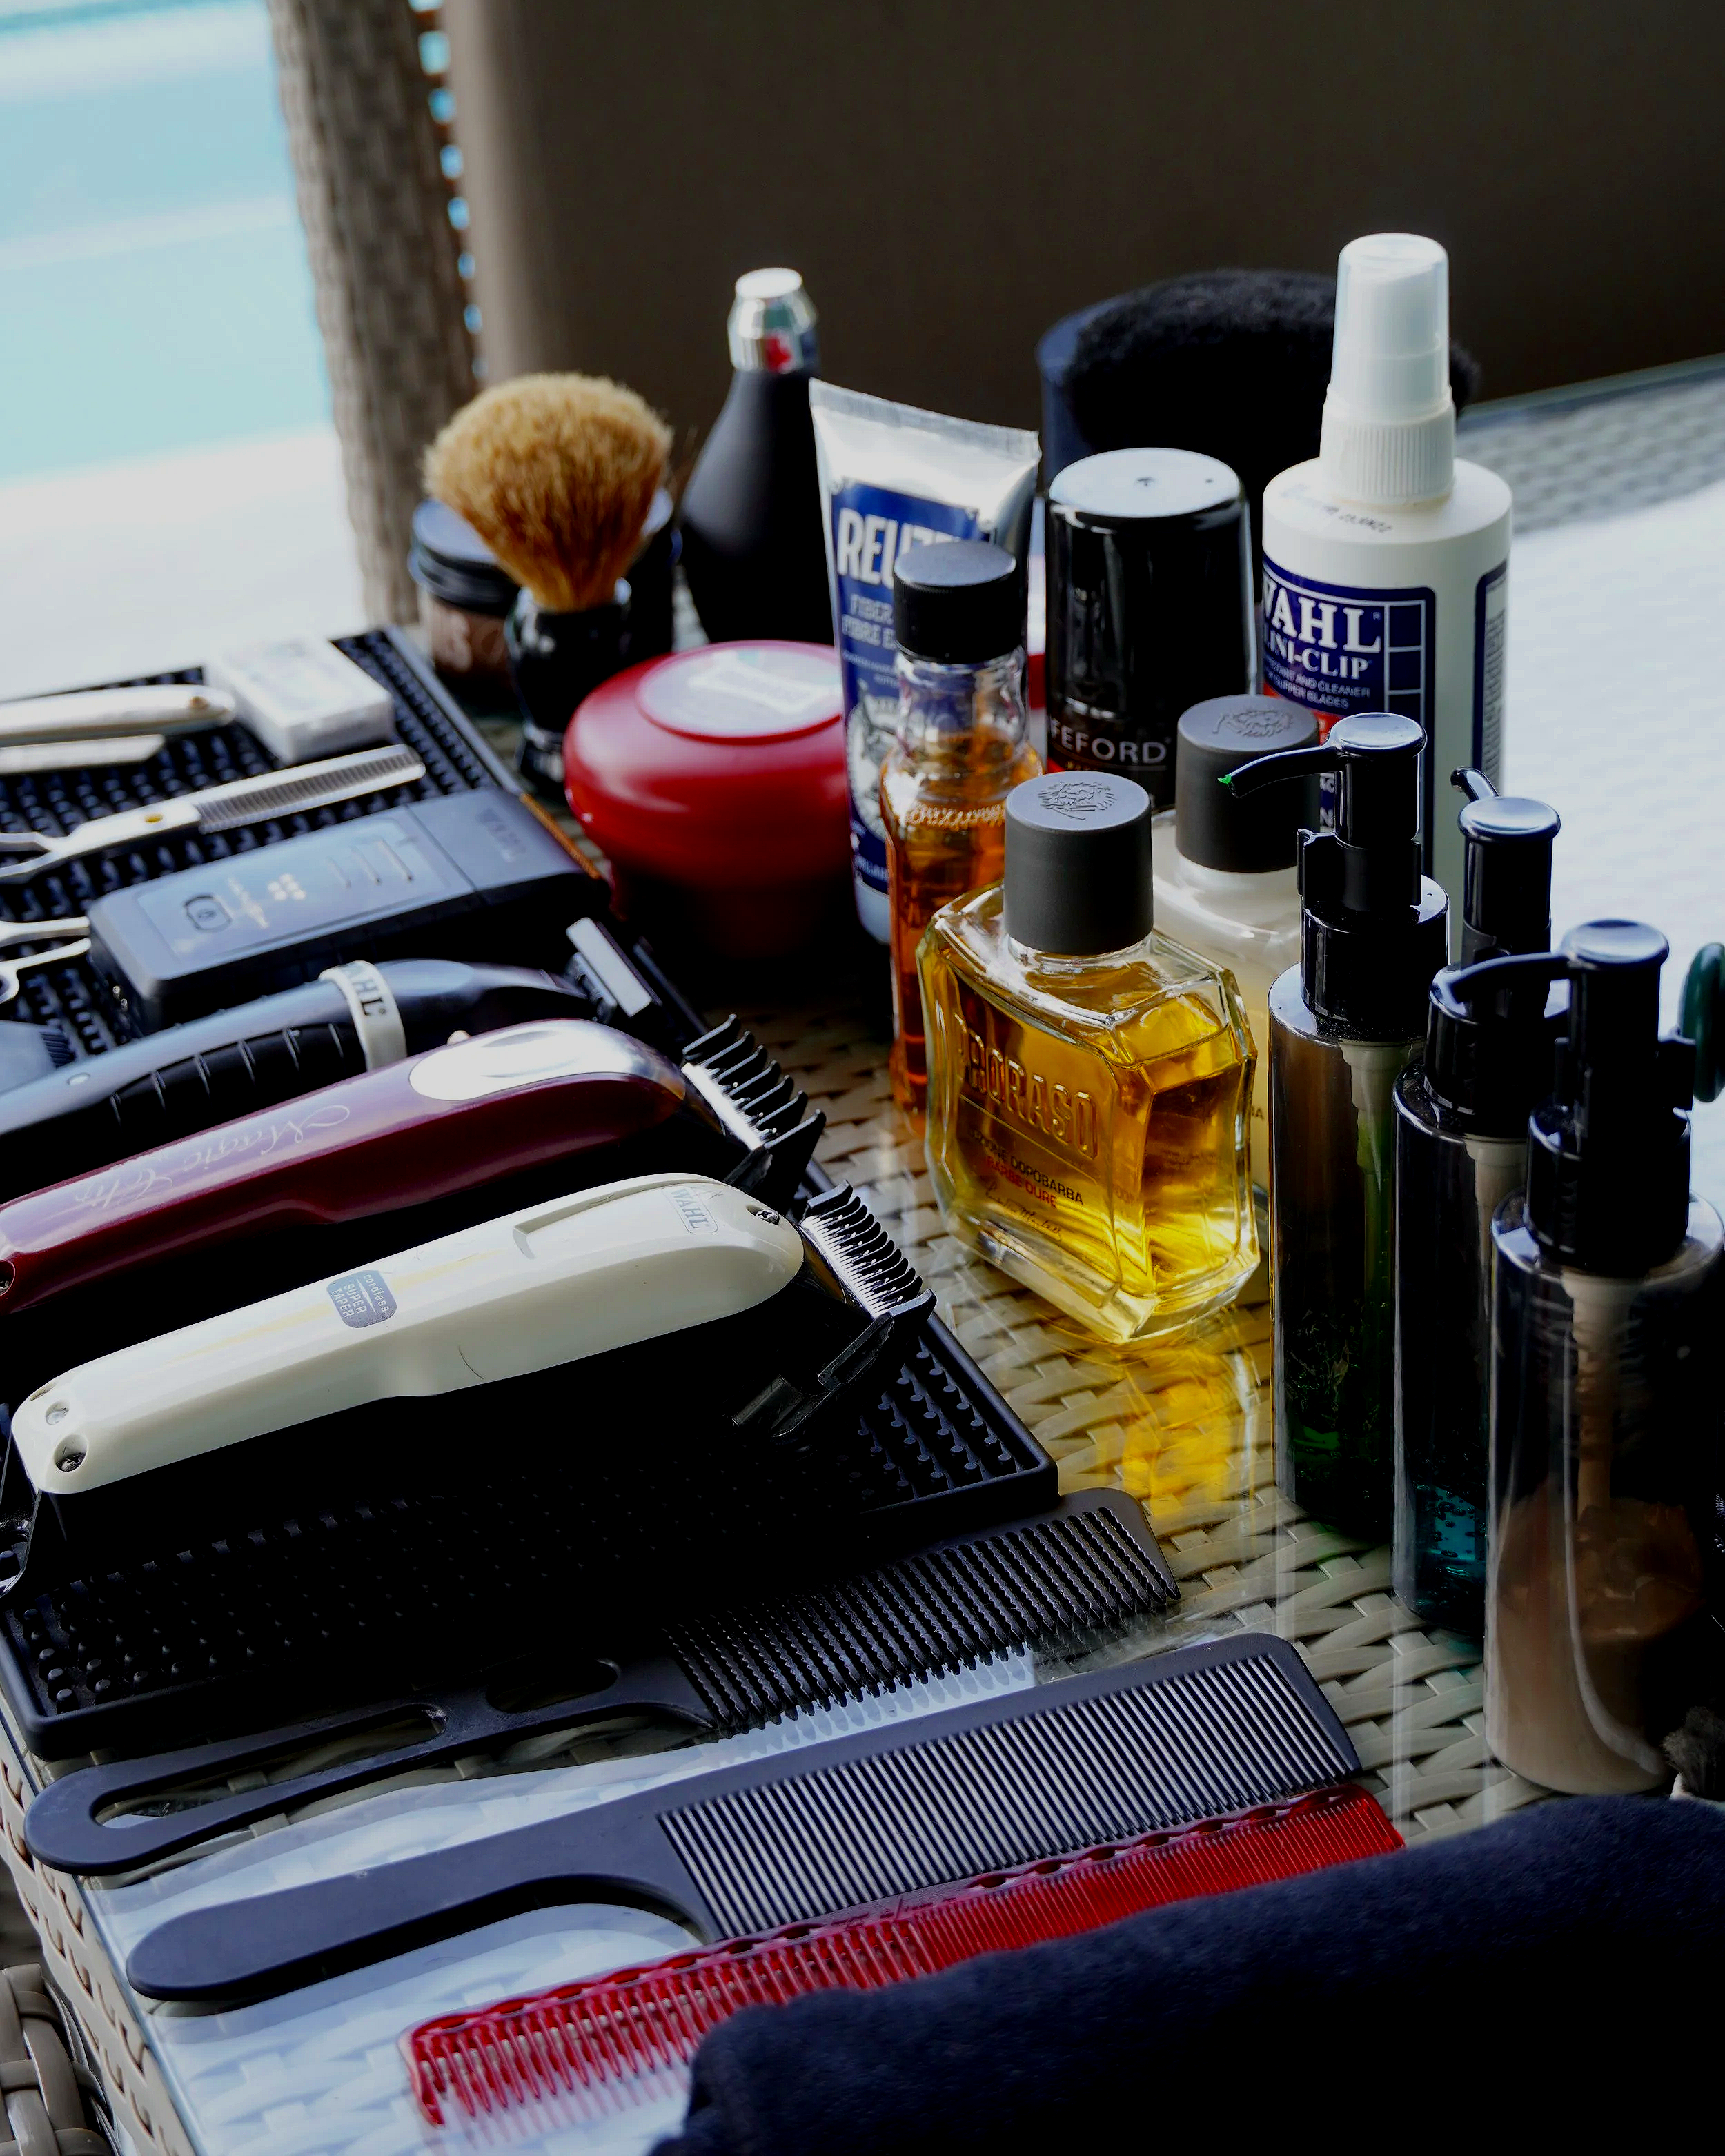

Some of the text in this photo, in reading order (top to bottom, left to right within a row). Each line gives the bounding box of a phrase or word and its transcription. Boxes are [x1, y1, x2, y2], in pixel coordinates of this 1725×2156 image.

[836, 507, 962, 589] REU
[1306, 690, 1349, 709] BLADES
[1010, 1156, 1083, 1205] DOPOBARBA
[1025, 1180, 1057, 1209] DURE
[671, 1187, 709, 1229] WAHL
[331, 1287, 355, 1318] TAPER
[344, 1283, 368, 1314] SUPER
[363, 1274, 390, 1312] cordless
